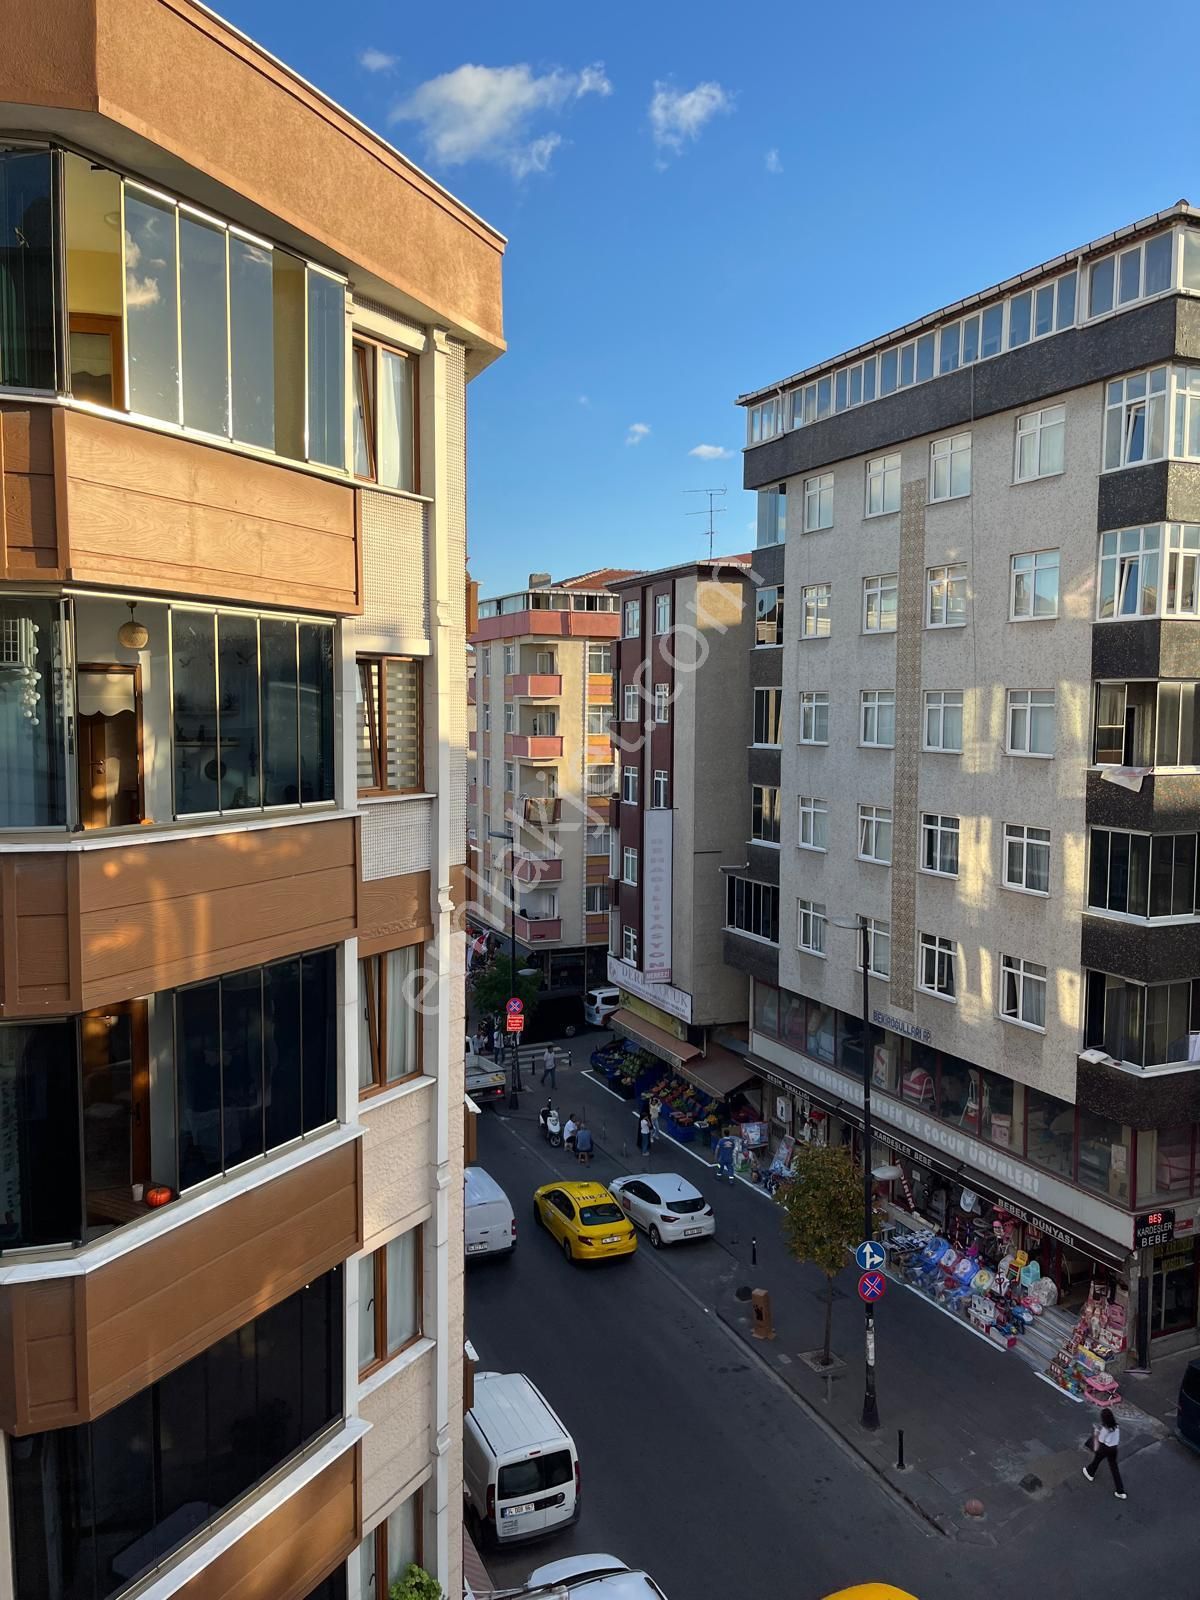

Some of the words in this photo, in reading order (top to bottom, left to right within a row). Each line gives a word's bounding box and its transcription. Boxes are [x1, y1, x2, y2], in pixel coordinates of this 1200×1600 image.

[906, 1114, 921, 1132] VE
[924, 1123, 965, 1155] ÇOCUK
[968, 1141, 1039, 1193] ÜRÜNLERİ
[914, 1152, 933, 1167] BEBE
[998, 1198, 1028, 1222] BEBEK
[1032, 1217, 1075, 1246] DÜNYASI
[1148, 1213, 1162, 1224] BEŞ
[1137, 1222, 1173, 1238] KARDEŞLER
[1141, 1233, 1168, 1247] BEBE
